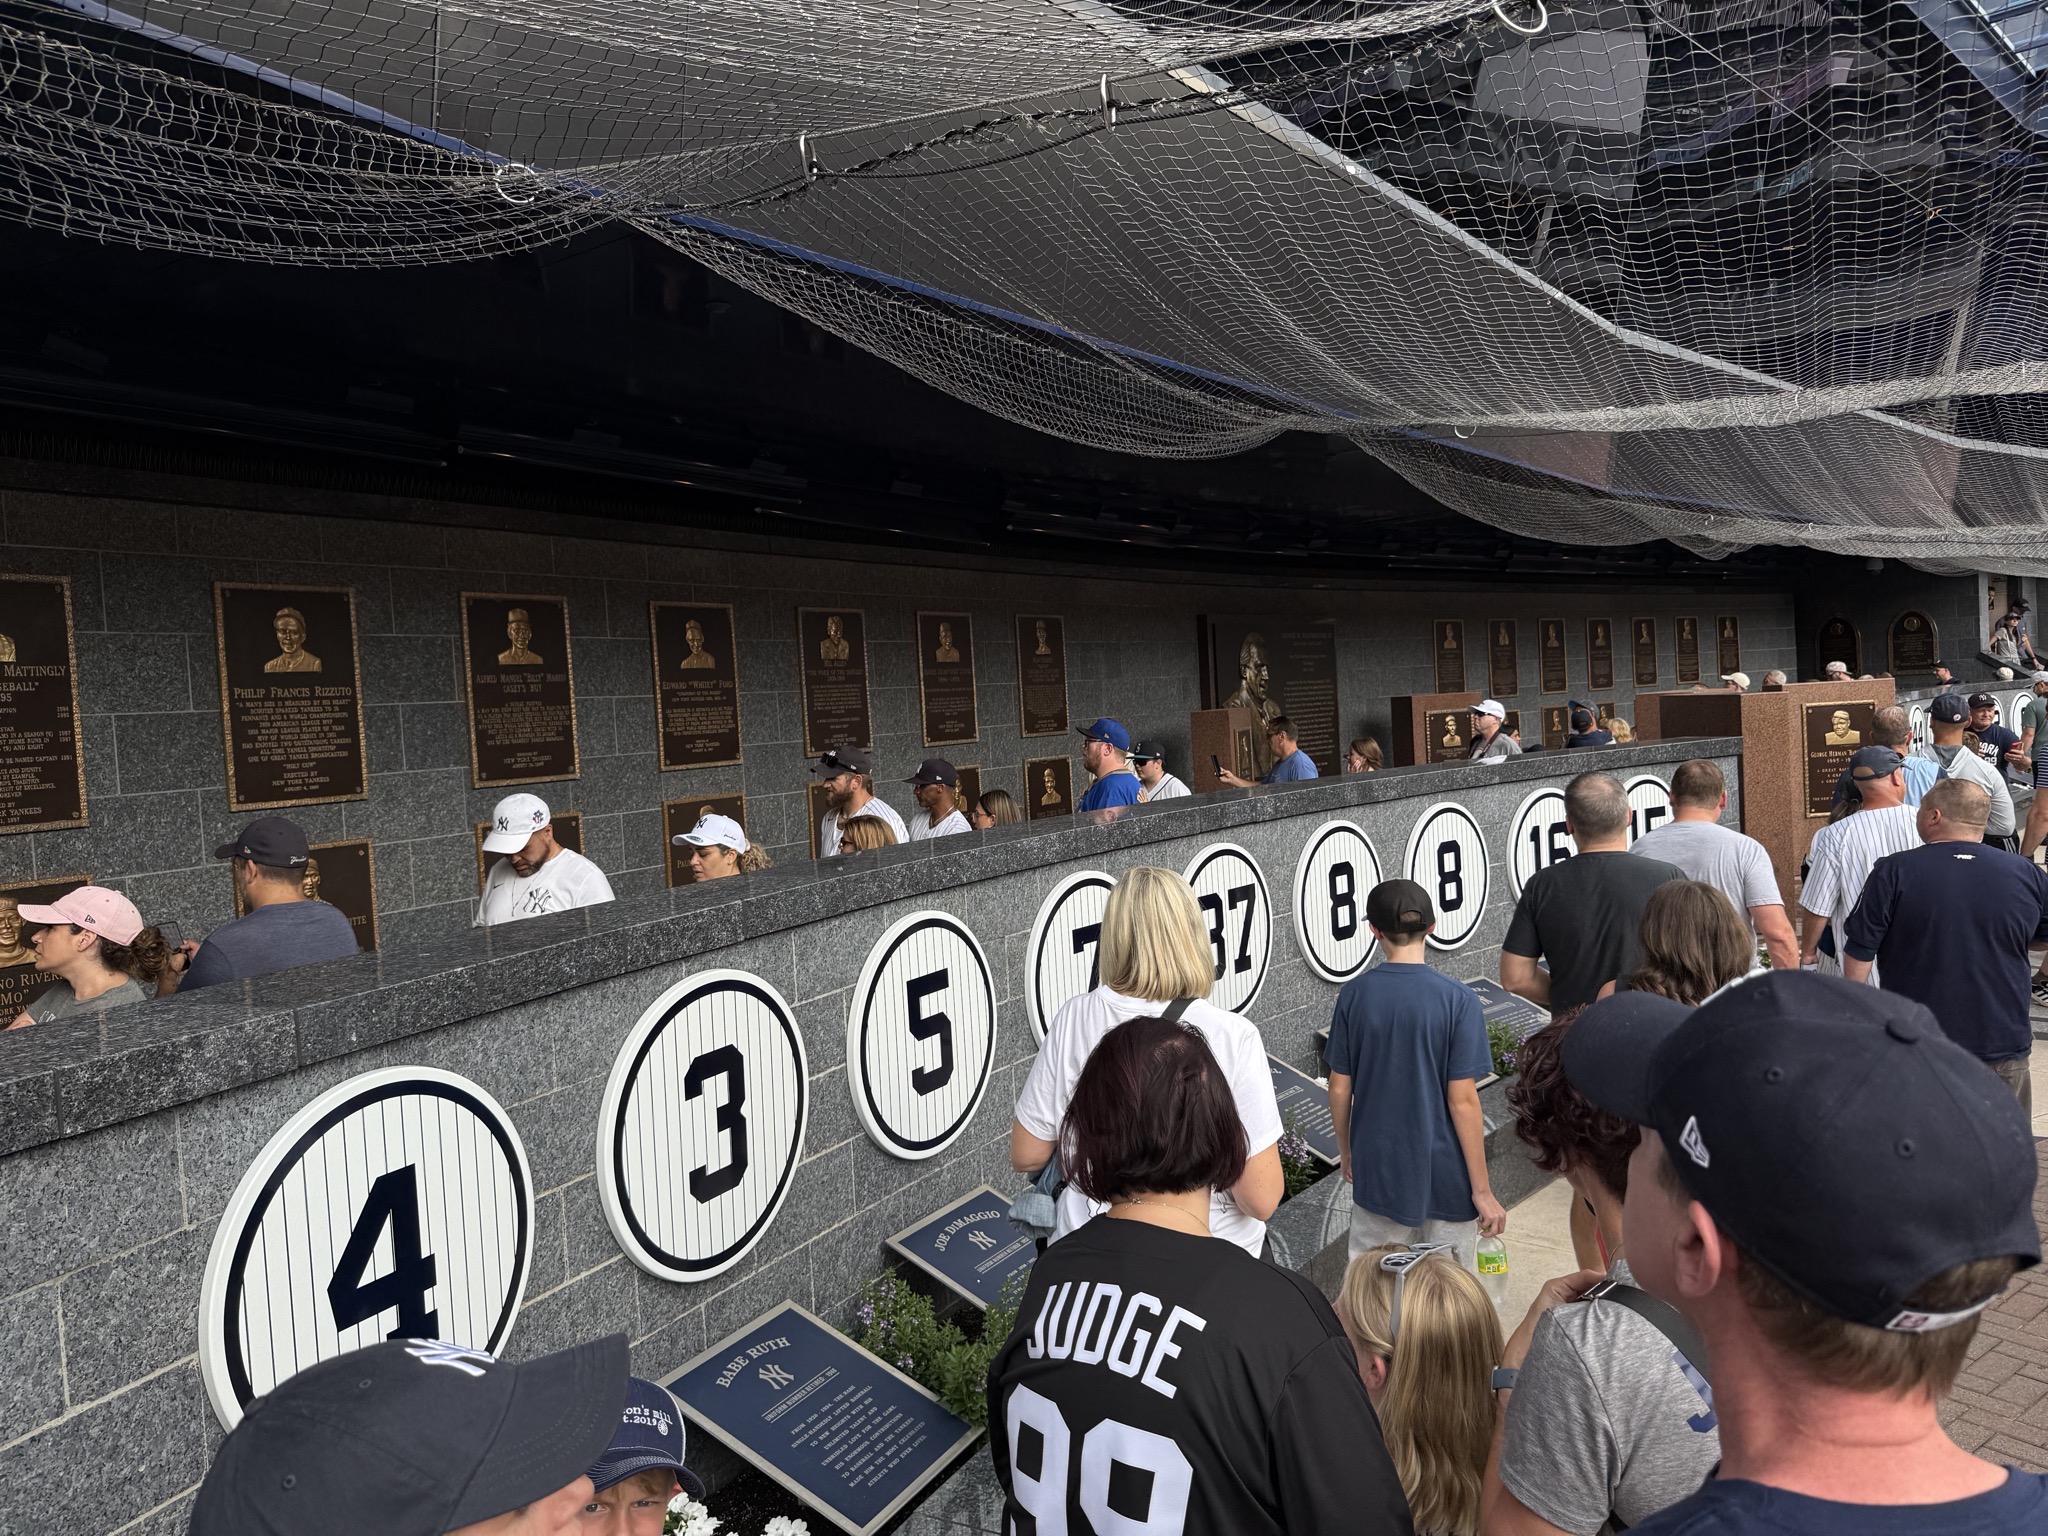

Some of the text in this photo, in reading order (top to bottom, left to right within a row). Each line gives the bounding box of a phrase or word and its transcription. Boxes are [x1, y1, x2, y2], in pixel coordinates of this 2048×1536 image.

[4, 665, 66, 677] MATTINGLY
[476, 675, 498, 683] ALFRED
[662, 681, 687, 690] EDWARD
[234, 686, 352, 699] PHILIP FRANCIS RIZZUTO
[1913, 721, 1923, 751] 44
[9, 808, 42, 816] YANKEES
[497, 816, 509, 831] NY
[1437, 840, 1464, 913] 8
[523, 887, 551, 913] NY
[1328, 860, 1357, 942] 8
[20, 971, 63, 986] RIVER
[906, 968, 953, 1096] 5
[684, 1044, 748, 1204] 3
[327, 1163, 438, 1341] 4
[935, 1233, 950, 1252] JOE
[968, 1230, 997, 1250] NY
[1026, 1281, 1207, 1400] JUDGE
[716, 1336, 791, 1388] BABE RUTH
[758, 1363, 795, 1390] NY
[623, 1404, 649, 1415] on's
[764, 1403, 789, 1422] UNIFORM
[786, 1389, 807, 1406] NUMBER
[791, 1423, 806, 1435] FROM
[834, 1393, 844, 1403] THE
[843, 1384, 856, 1396] BABE
[833, 1402, 850, 1416] LIFTED
[850, 1385, 873, 1403] BASEBALL
[818, 1430, 830, 1441] NEW
[830, 1414, 851, 1431] HEIGHTS
[851, 1404, 864, 1415] WITH
[823, 1406, 878, 1450] UNLIMITED TALENT AND
[834, 1412, 904, 1470] HIS ENORMOUS CONTRIBUTIONS
[821, 1444, 849, 1467] UNBRIDLED
[848, 1433, 862, 1445] LOVE
[862, 1425, 872, 1434] FOR
[872, 1416, 883, 1425] THE
[842, 1417, 915, 1479] TO BASEBALL AND THE YANKEES
[849, 1421, 926, 1488] MADE HIM THE MOST CELEBRATED
[1007, 1382, 1194, 1536] 99
[868, 1468, 889, 1487] ATHLETE
[888, 1458, 900, 1469] WHO
[900, 1447, 913, 1459] EVER
